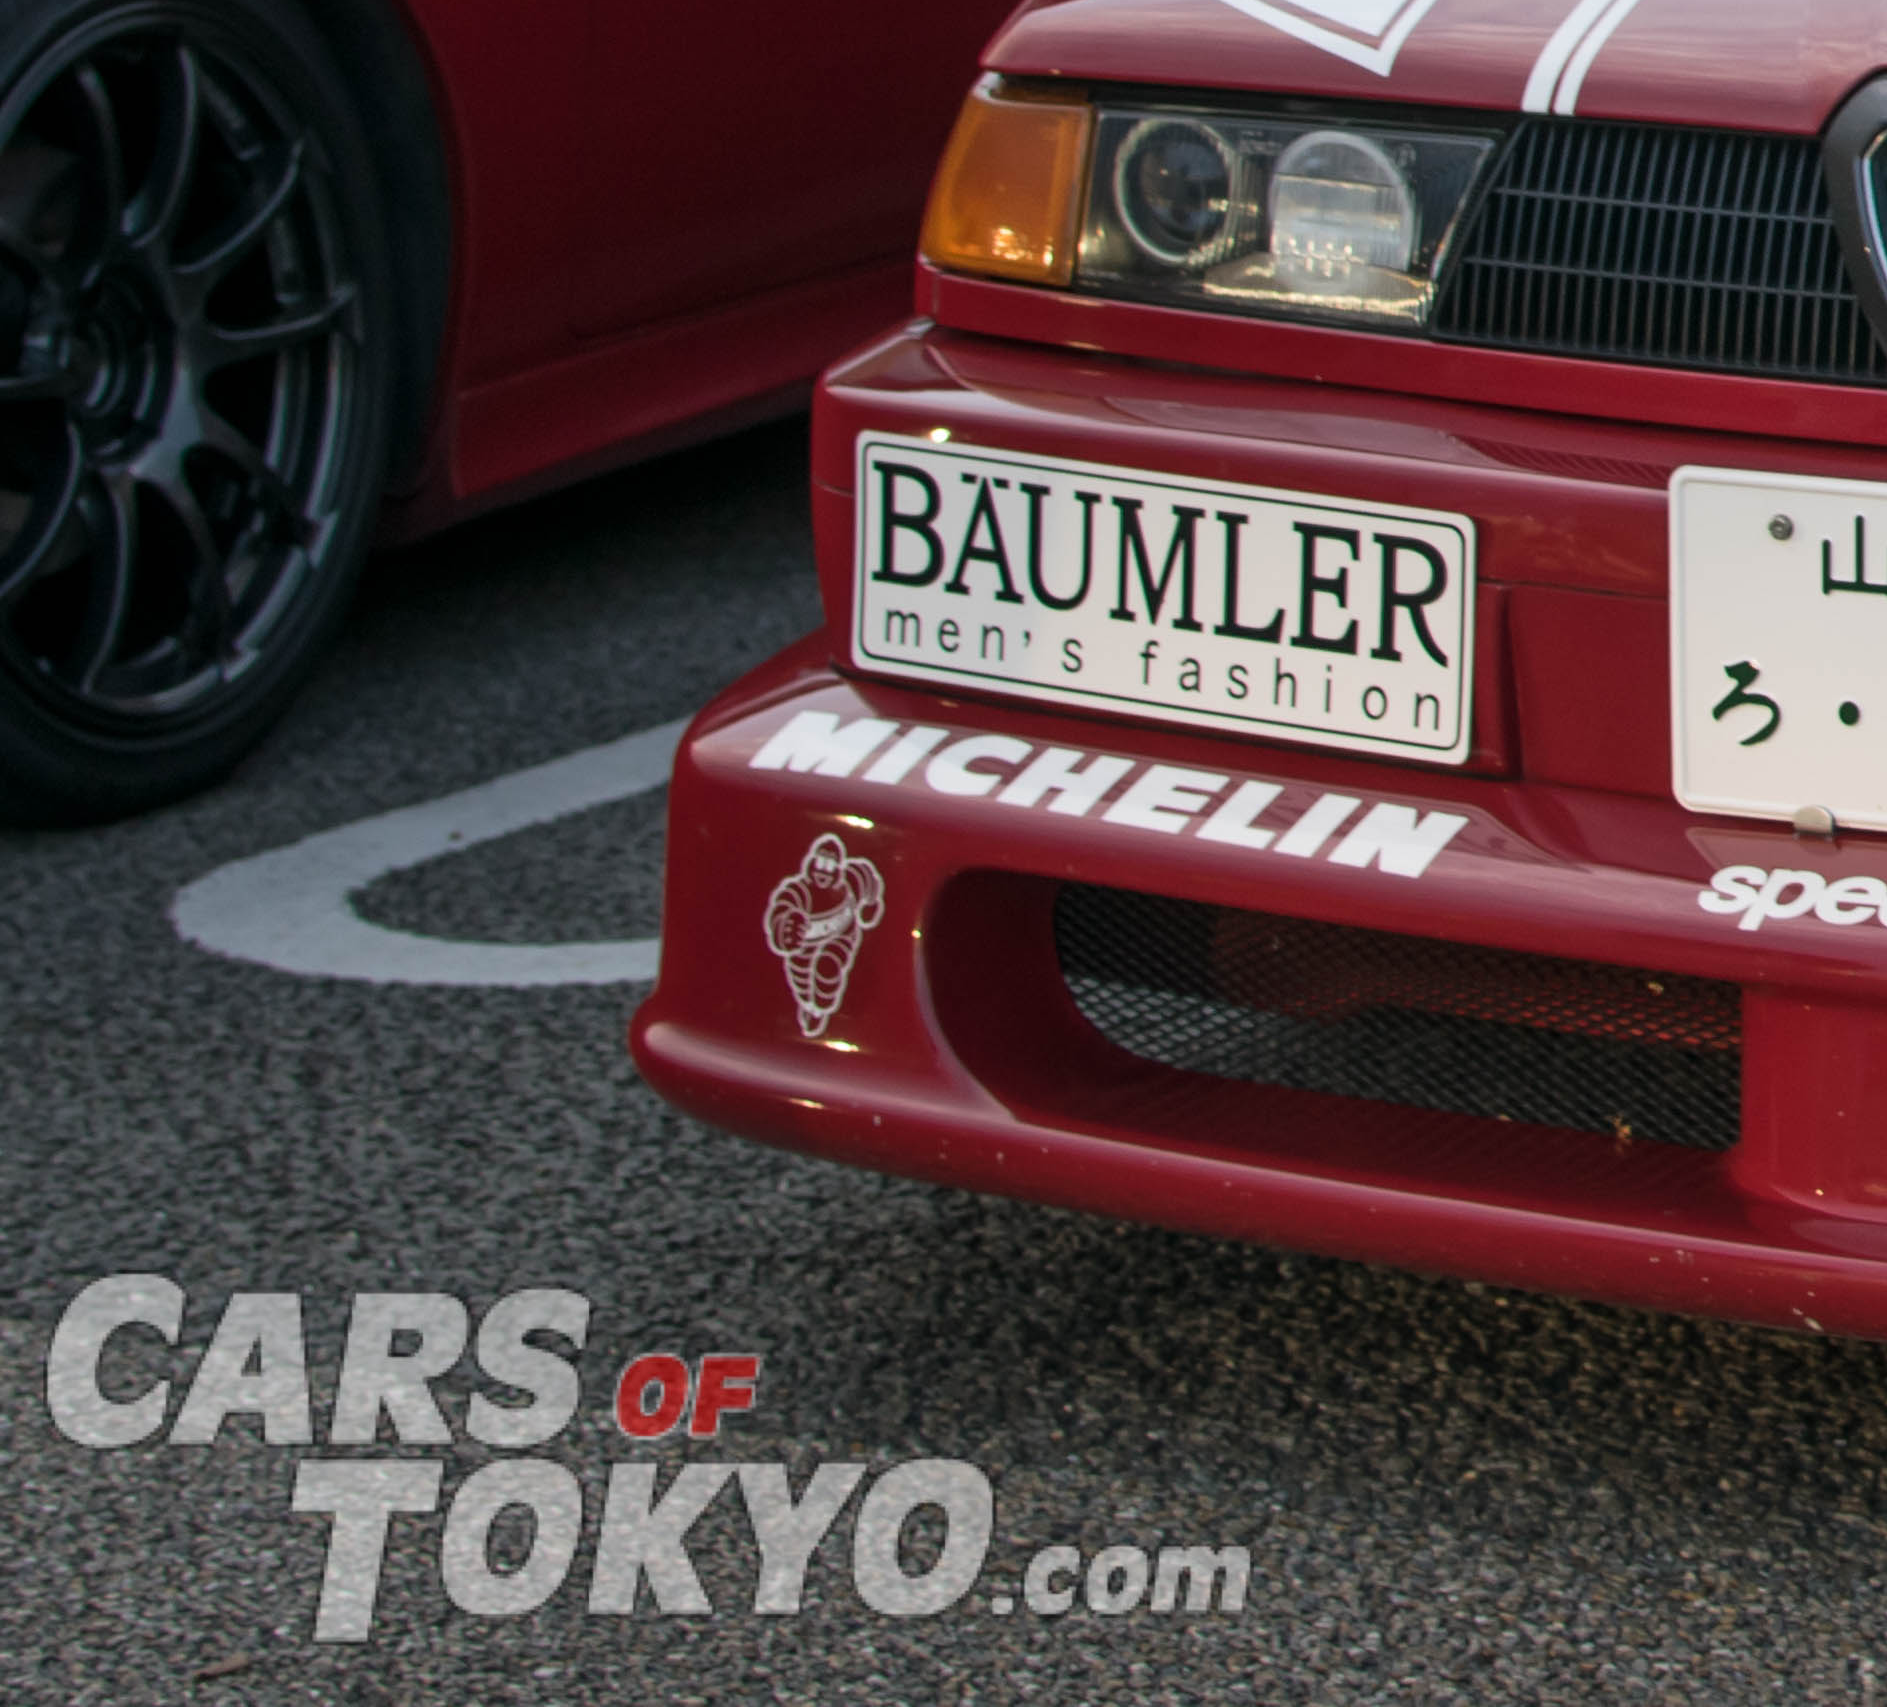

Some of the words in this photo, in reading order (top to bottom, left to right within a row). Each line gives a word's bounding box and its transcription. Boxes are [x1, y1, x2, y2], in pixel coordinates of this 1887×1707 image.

[871, 459, 1449, 669] BÄUMLER
[884, 605, 1084, 674] men's
[1140, 640, 1443, 732] fashion
[747, 709, 1471, 880] MICHELIN
